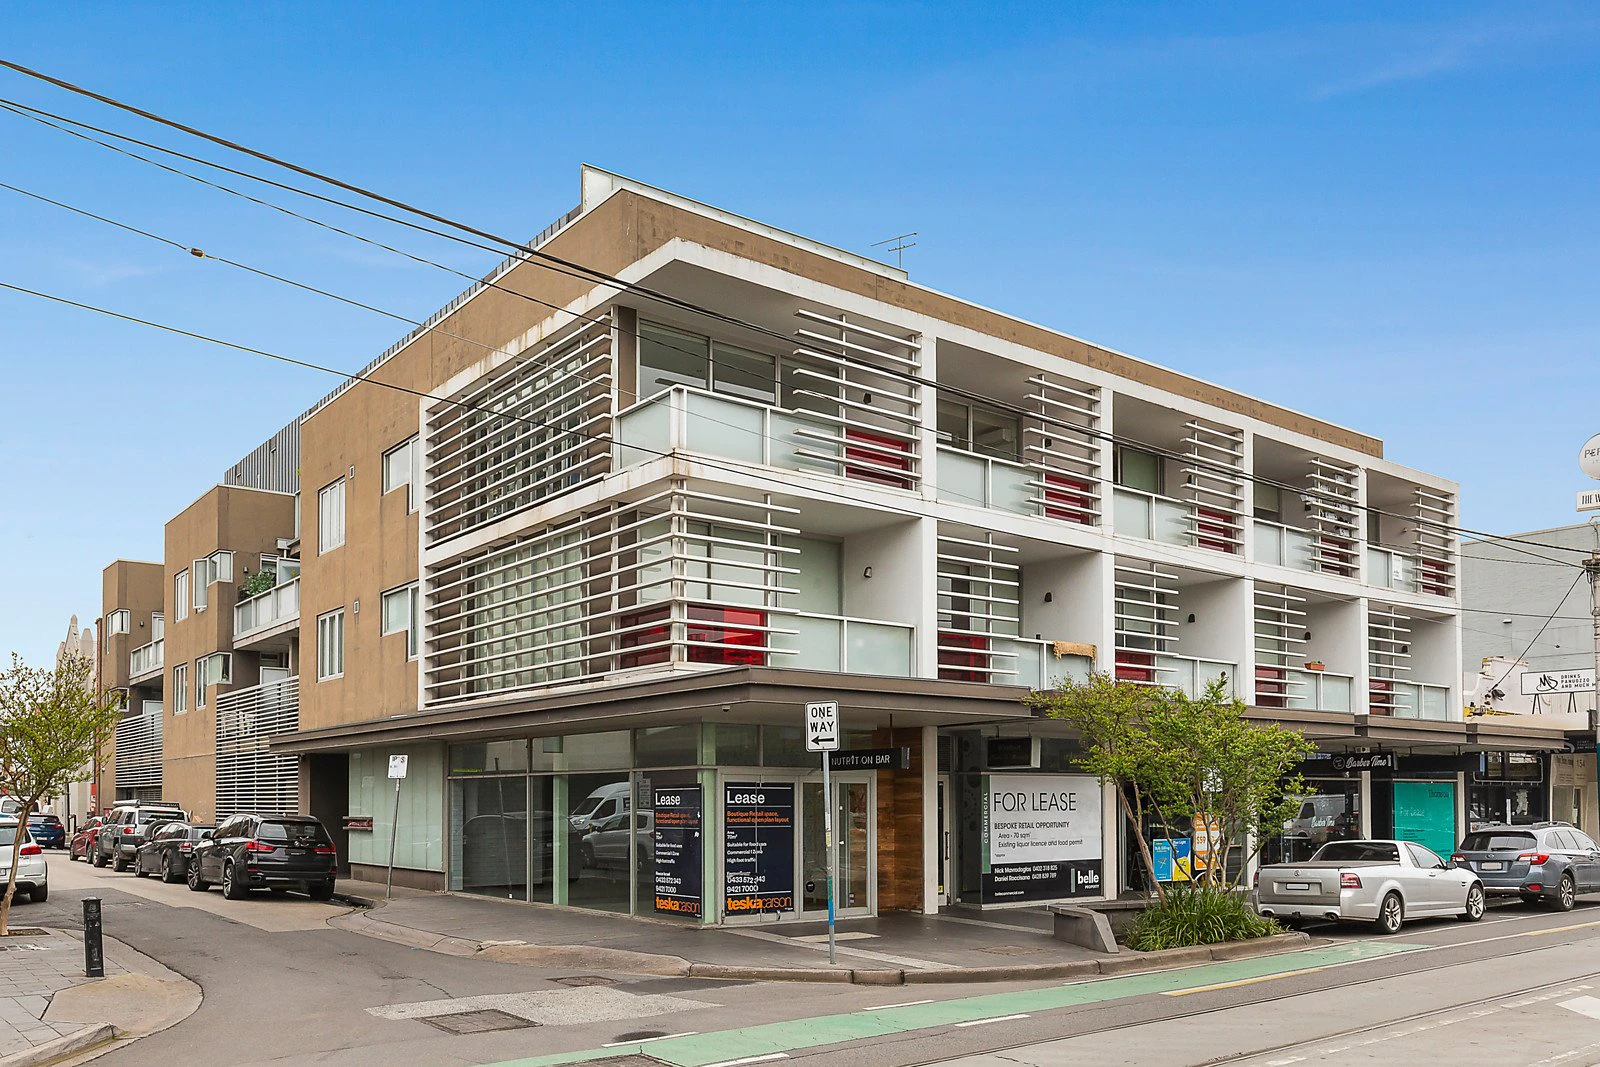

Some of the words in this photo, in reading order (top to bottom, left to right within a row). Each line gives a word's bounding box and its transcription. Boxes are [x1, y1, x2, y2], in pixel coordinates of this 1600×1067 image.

[811, 706, 832, 718] ONE
[810, 721, 834, 733] WAY
[876, 754, 890, 764] BAR
[1346, 757, 1370, 768] Barber
[1371, 755, 1386, 767] Time
[656, 792, 680, 805] Lease
[727, 790, 765, 804] Lease
[994, 792, 1027, 811] FOR
[1032, 792, 1077, 811] LEASE
[1078, 870, 1099, 884] belle
